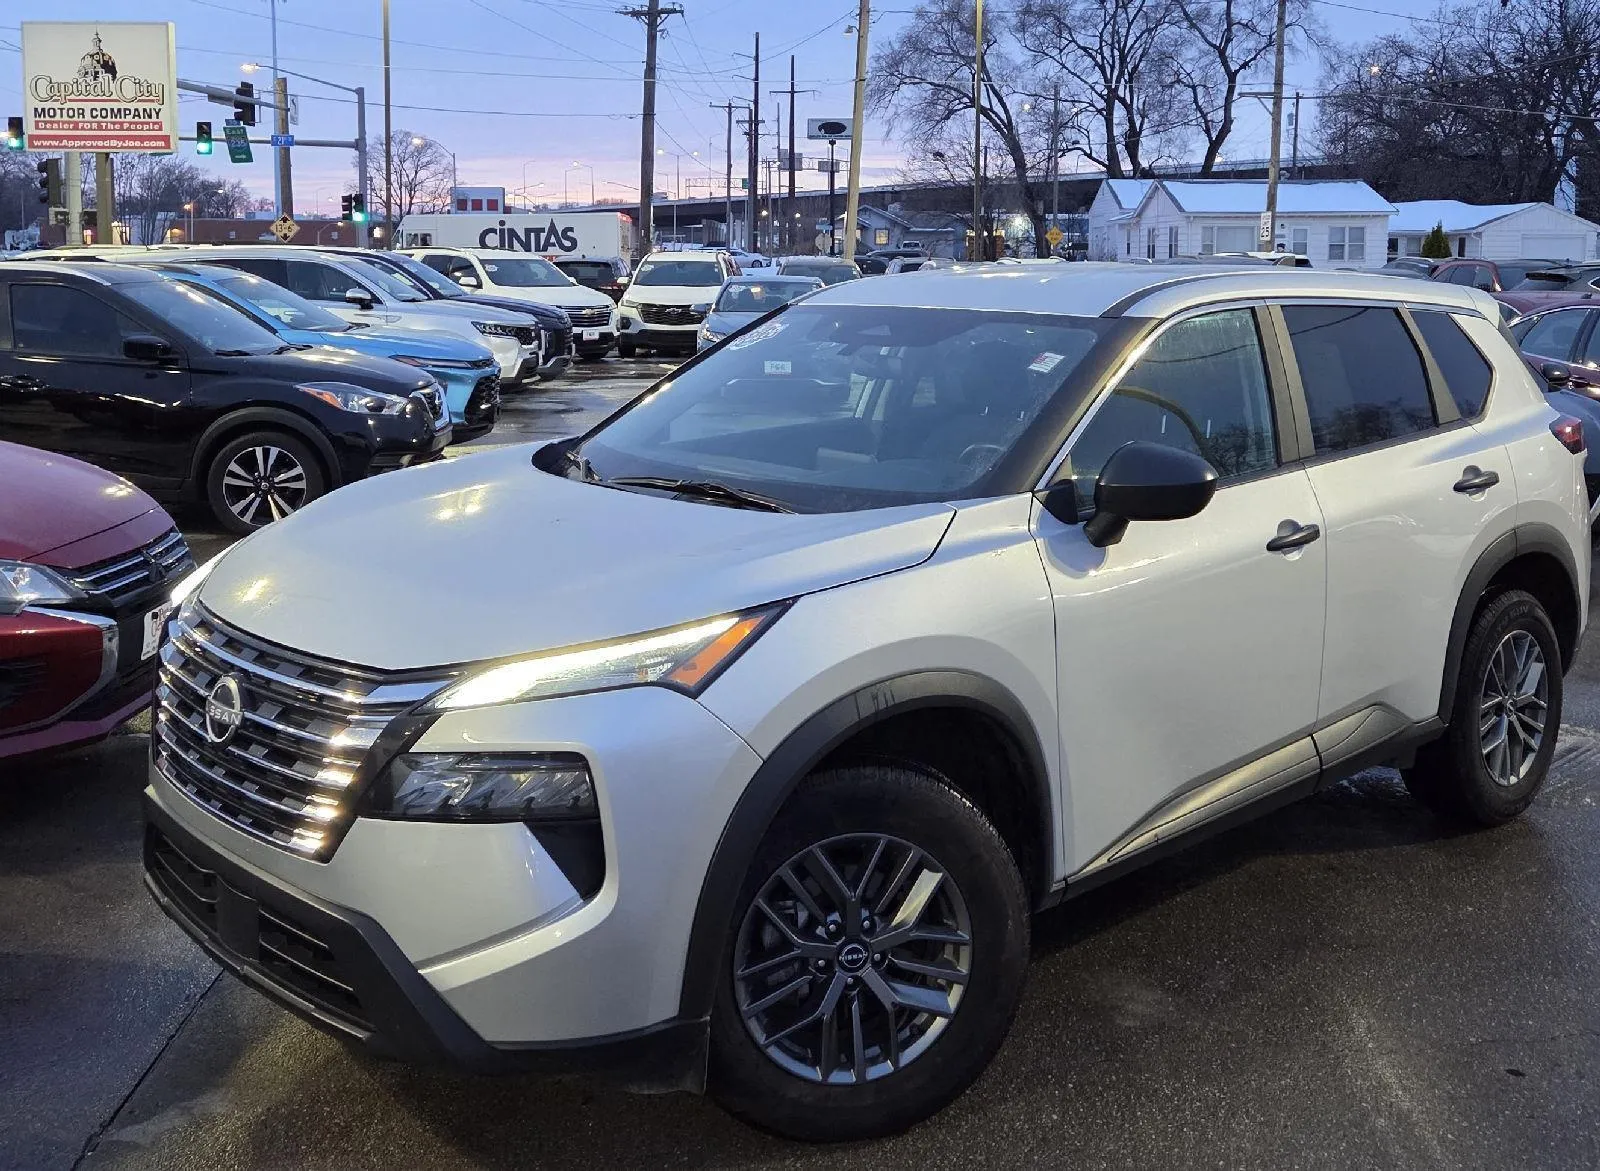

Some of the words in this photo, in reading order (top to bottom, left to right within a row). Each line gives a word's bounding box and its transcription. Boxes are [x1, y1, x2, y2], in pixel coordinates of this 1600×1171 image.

[30, 74, 113, 105] Capital
[115, 75, 164, 105] City
[33, 107, 86, 119] MOTOR
[90, 107, 162, 119] COMPANY
[38, 122, 75, 130] Dealer
[78, 122, 99, 130] FOR
[100, 122, 121, 130] The
[33, 139, 166, 148] www.ApprovedByJoe.com
[1261, 226, 1270, 238] 25
